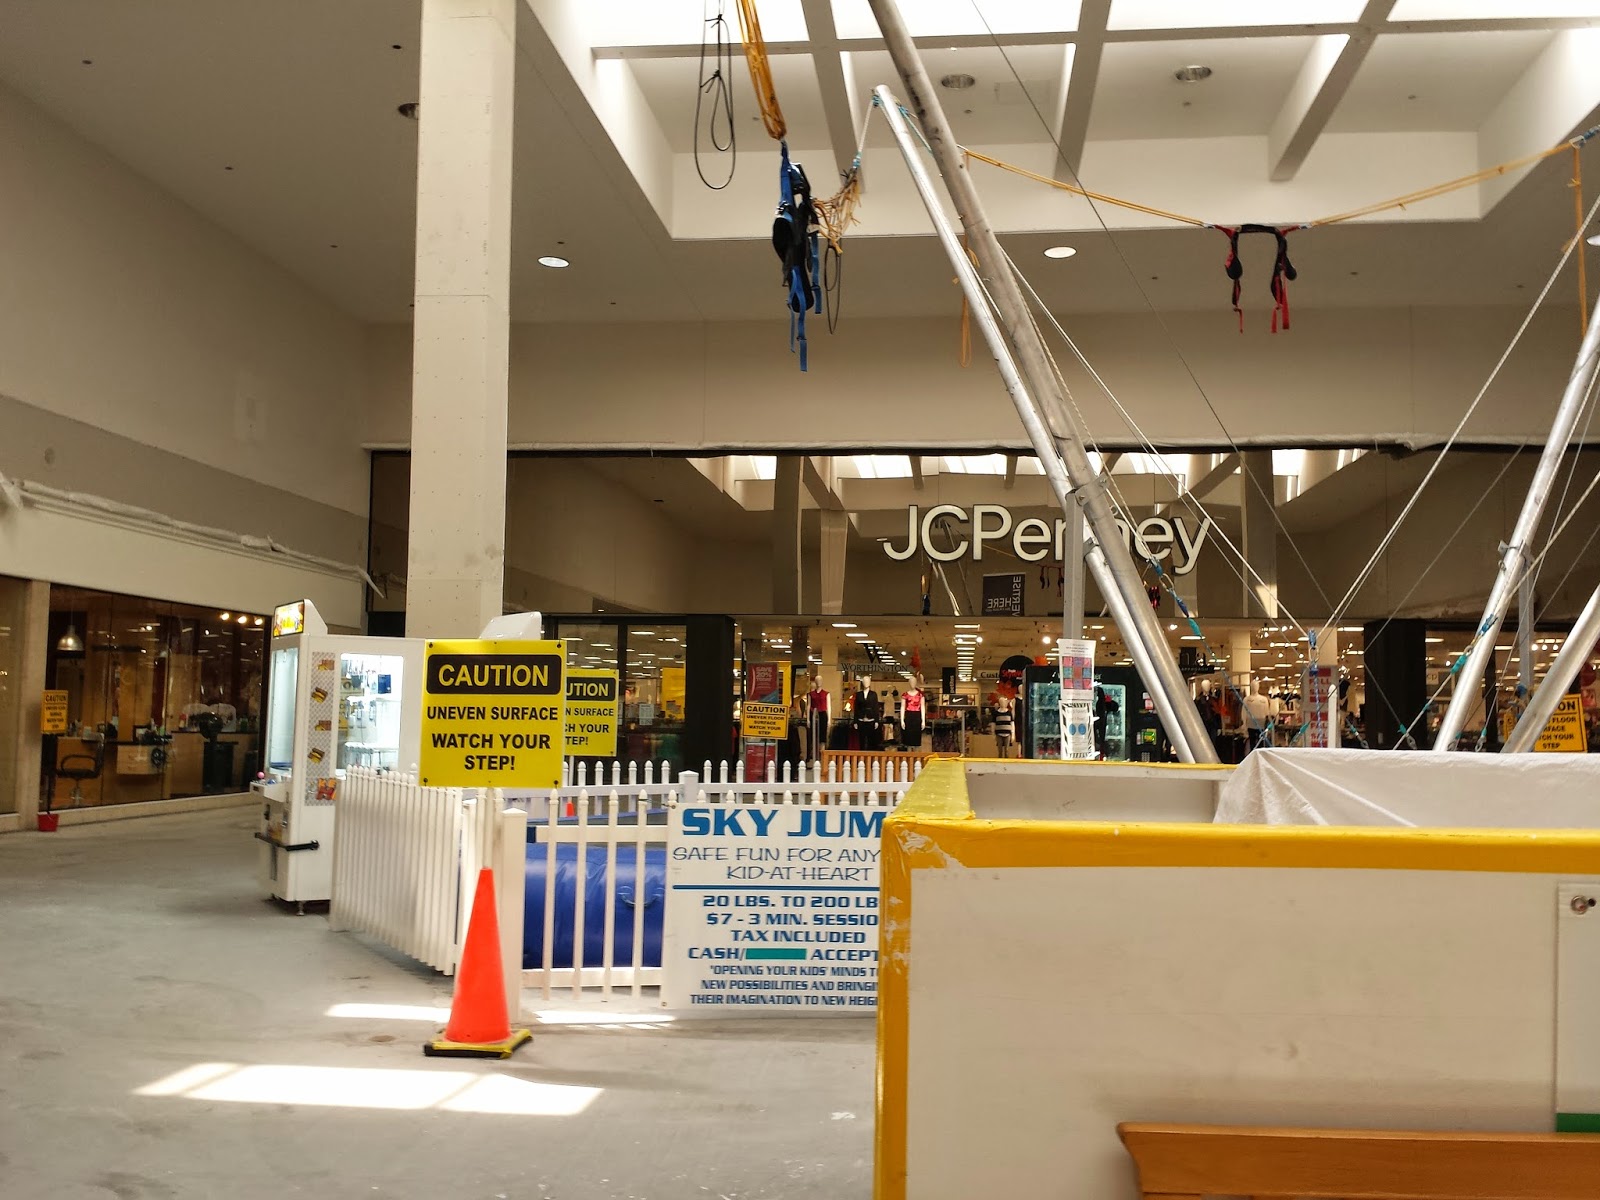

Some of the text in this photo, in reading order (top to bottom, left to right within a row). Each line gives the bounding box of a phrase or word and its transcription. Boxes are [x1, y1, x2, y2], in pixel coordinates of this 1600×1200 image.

[840, 663, 908, 672] WORTHINGTON
[438, 664, 549, 687] CAUTION
[566, 682, 609, 697] UTION
[427, 706, 558, 721] UNEVEN SURFACE
[574, 707, 614, 716] SURFACE
[746, 705, 785, 713] CAUTION
[579, 724, 609, 733] YOUR
[432, 733, 551, 750] WATCH YOUR
[464, 755, 515, 771] STEP!
[682, 808, 779, 837] SKY
[673, 847, 881, 862] SAFE FUN FOR ANY
[727, 866, 874, 881] KID-AT-HEART
[703, 895, 878, 908] 20 LBS. TO 200 LB
[706, 912, 733, 925] $7
[749, 913, 761, 925] 3
[766, 913, 808, 925] MIN.
[813, 914, 878, 926] SESSIO
[731, 930, 866, 943] TAX INCLUDED
[688, 947, 745, 961] CASH/
[766, 966, 797, 975] YOUR
[831, 967, 867, 976] MINDS
[869, 968, 878, 976] T
[701, 980, 878, 991] NEW POSSIBILITIES AND BRINGI
[690, 994, 878, 1006] THEIR IMAGINATION TO NEW HEIG
